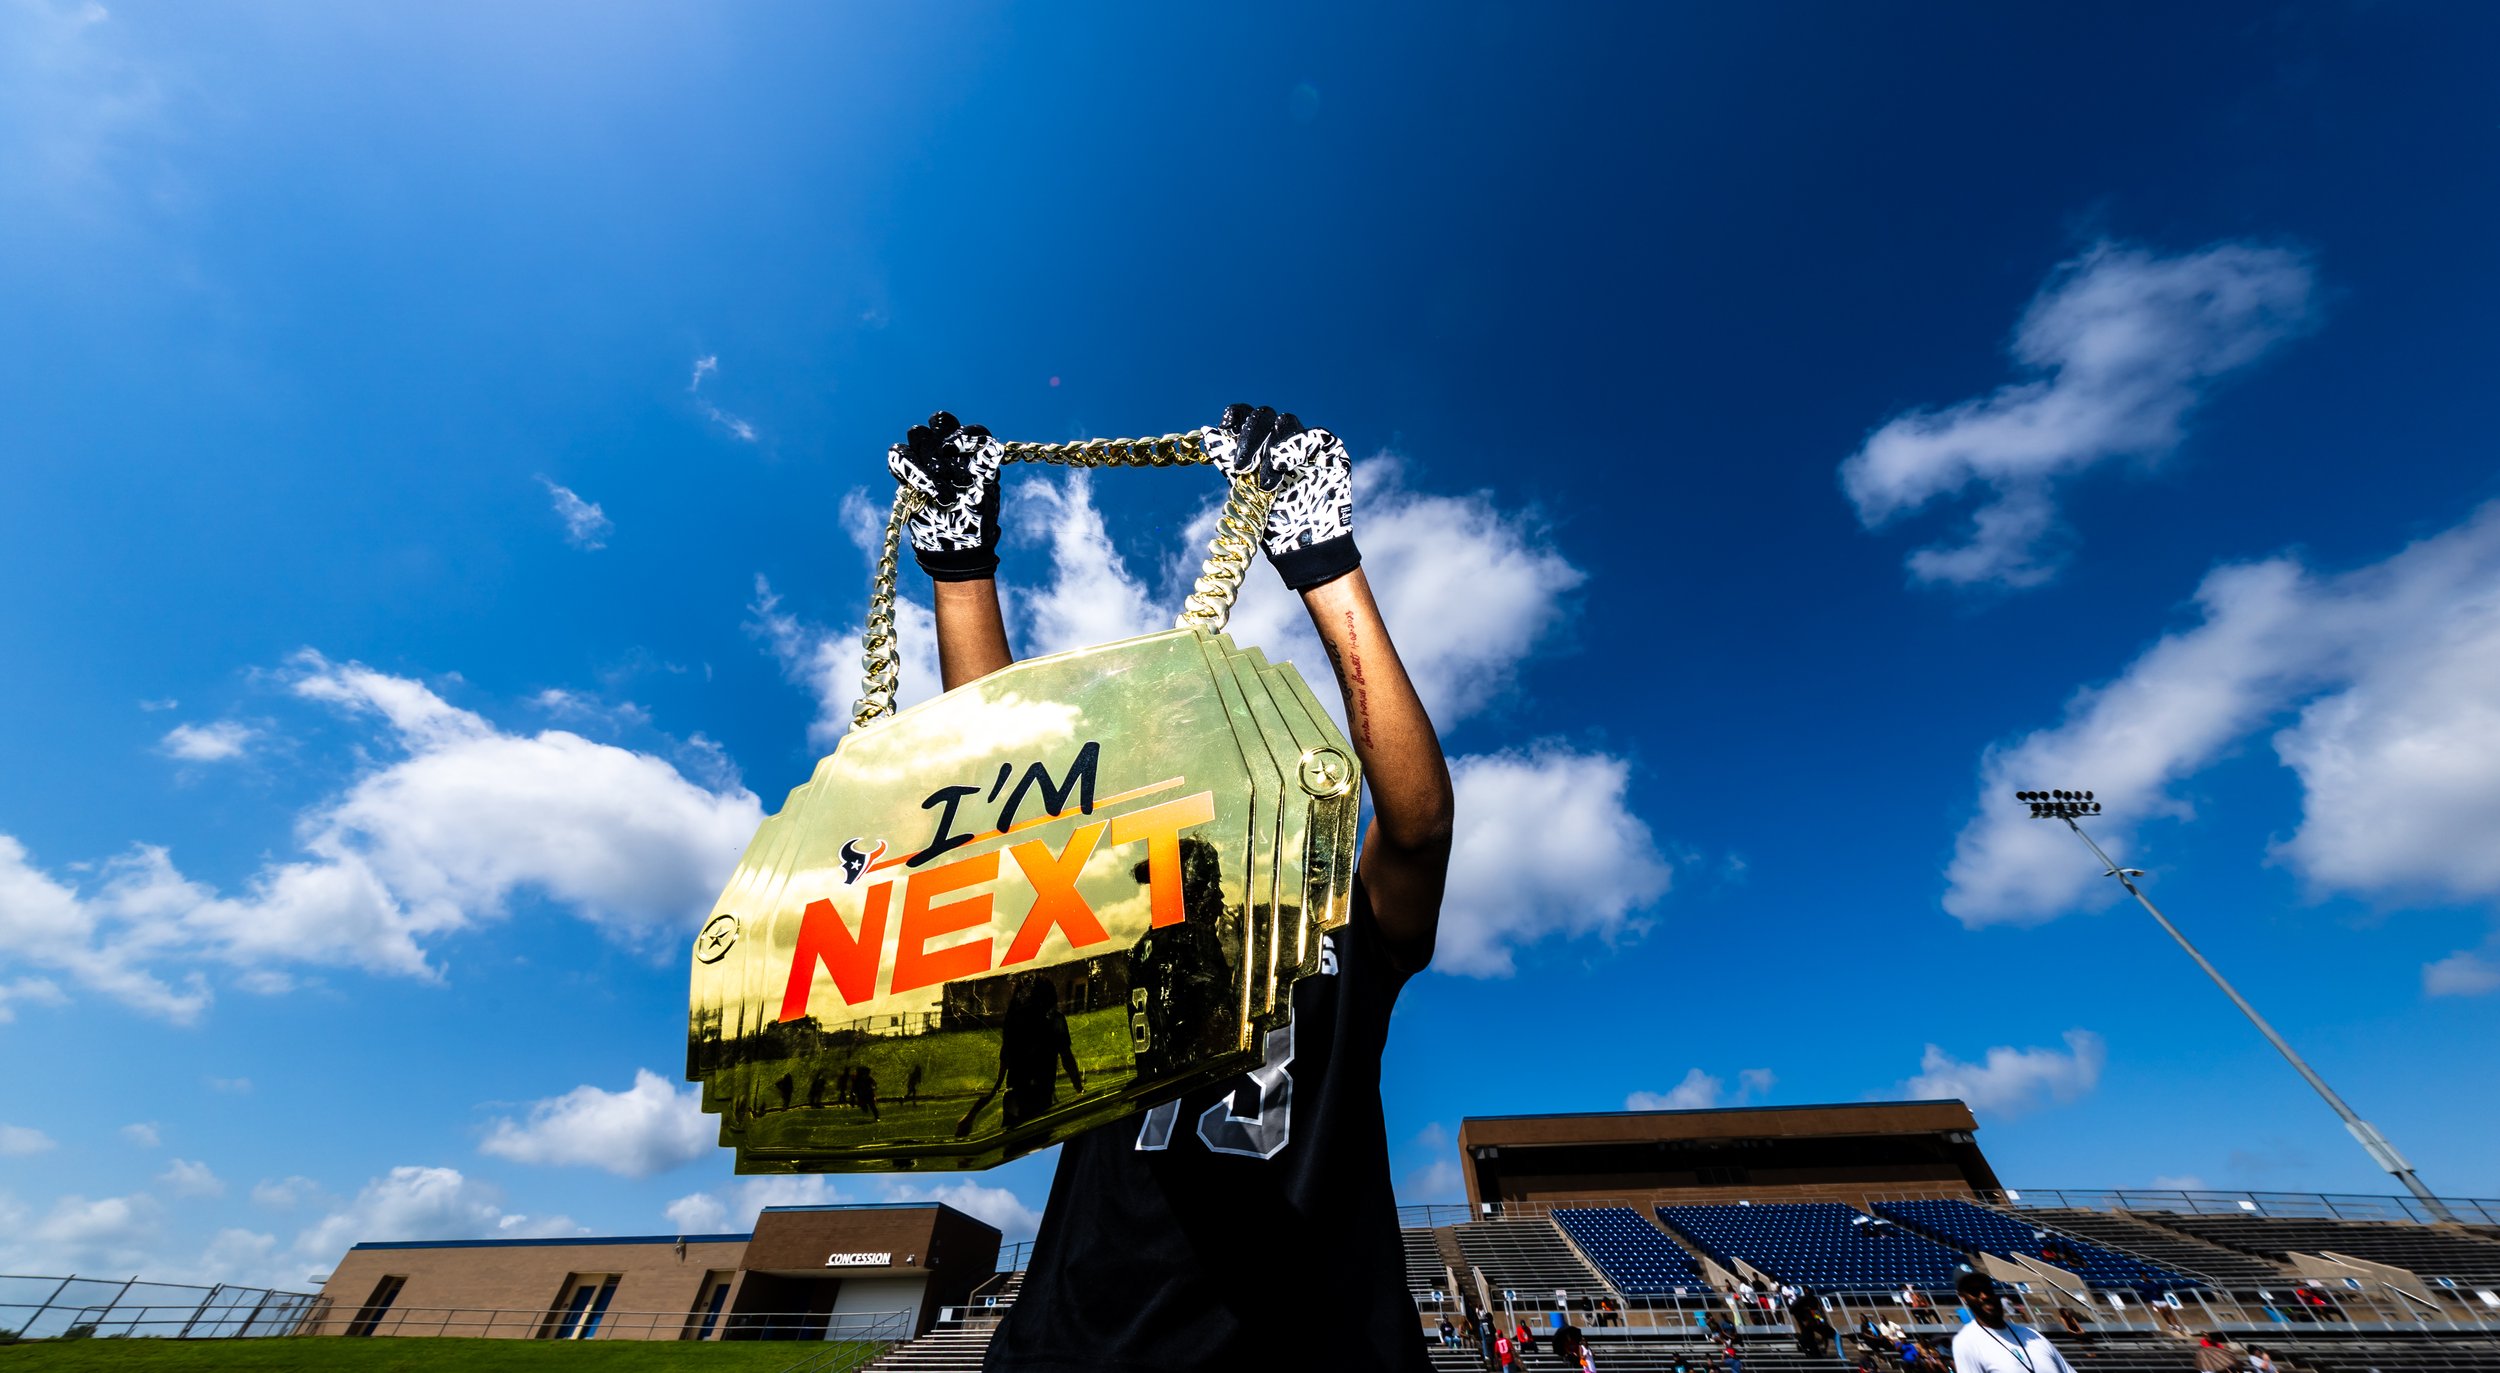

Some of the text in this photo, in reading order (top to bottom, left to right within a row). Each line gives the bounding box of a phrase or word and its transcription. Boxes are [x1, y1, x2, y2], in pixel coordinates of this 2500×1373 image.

[905, 740, 1101, 868] I'M
[777, 789, 1216, 1025] NEXT
[827, 1252, 892, 1265] CONCESSION
